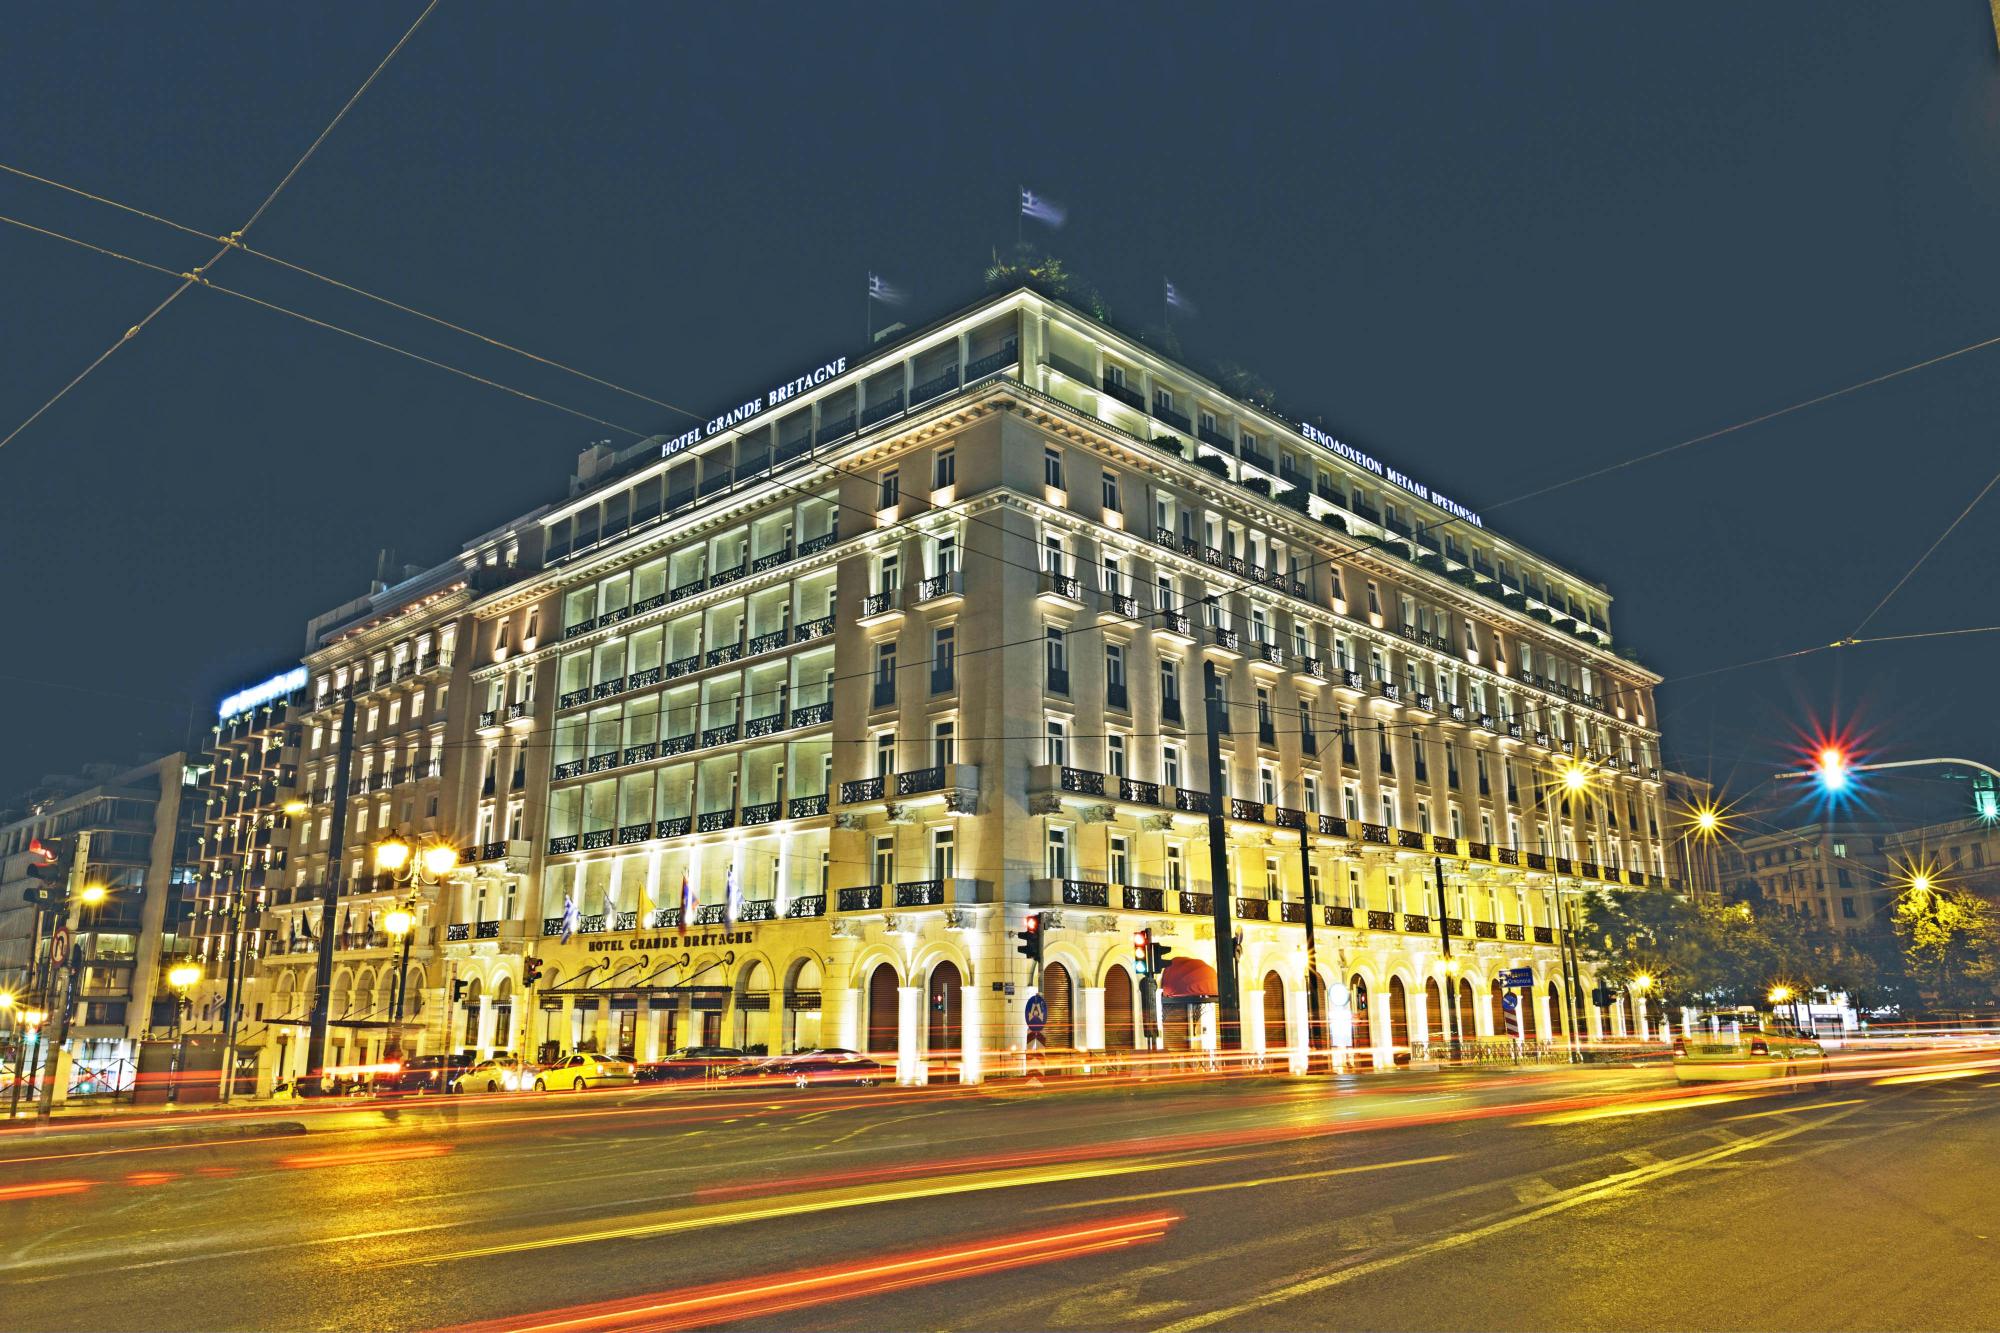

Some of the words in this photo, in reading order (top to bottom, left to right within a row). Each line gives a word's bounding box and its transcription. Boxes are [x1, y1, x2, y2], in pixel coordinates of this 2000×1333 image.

[661, 427, 702, 458] HOTEL
[706, 397, 762, 436] GRANDE
[768, 356, 846, 406] BRETAGNE
[1302, 422, 1382, 476] ΞΕΝΟΔΟΧΕΙΟΝ
[1386, 467, 1428, 500] ΜΕΓΑΛΗ
[1431, 491, 1483, 528] ΒΡΕΤΑΝΝΙΑ
[588, 940, 624, 952] HOTEL
[629, 936, 678, 950] GRANDE
[683, 931, 752, 947] BRETAGNE
